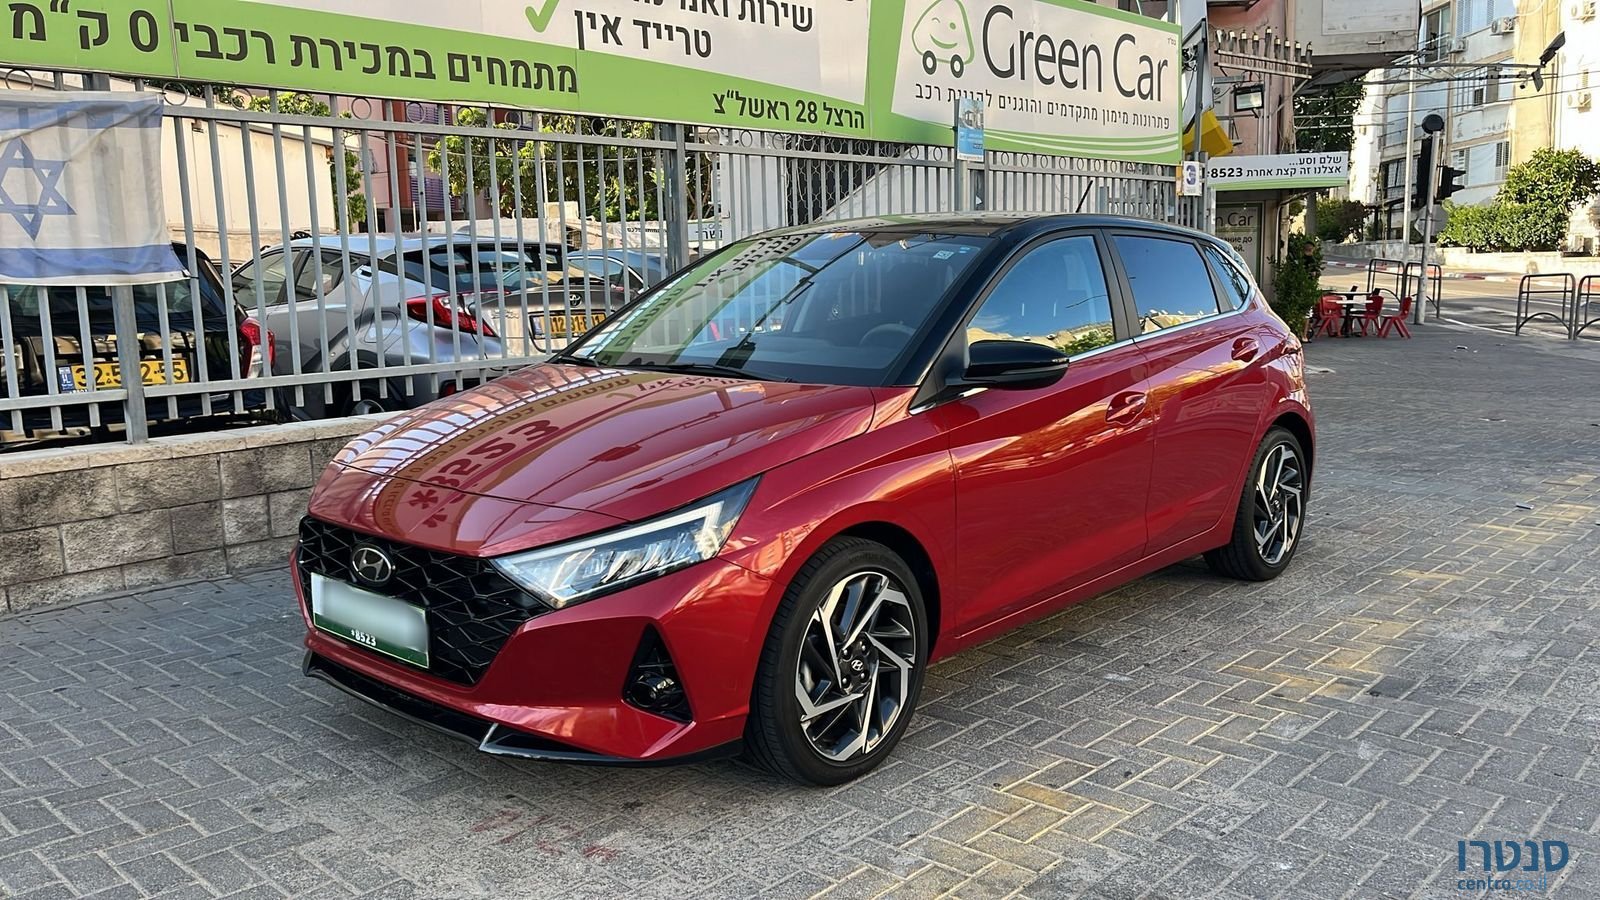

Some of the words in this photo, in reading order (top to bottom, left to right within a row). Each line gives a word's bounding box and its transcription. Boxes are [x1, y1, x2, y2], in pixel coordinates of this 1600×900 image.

[738, 0, 813, 32] שירות
[574, 9, 623, 50] אין
[633, 19, 712, 58] טרייד
[174, 22, 275, 64] רכבי
[982, 4, 1103, 93] Green
[1113, 33, 1169, 102] Car
[290, 34, 436, 80] במכירת
[448, 52, 577, 93] מתמחים
[915, 83, 941, 101] רכב
[796, 100, 818, 124] 28
[998, 94, 1042, 114] והוגנים
[1047, 101, 1098, 123] מתקדמים
[823, 102, 864, 129] הרצל
[1102, 107, 1129, 126] מימון
[1132, 113, 1171, 130] פתרונות
[1300, 166, 1311, 175] זה
[1313, 165, 1342, 175] אצלנו
[1320, 155, 1342, 165] שלם
[1246, 168, 1273, 177] אחרת
[1276, 167, 1297, 177] קצת
[1228, 212, 1253, 227] Car
